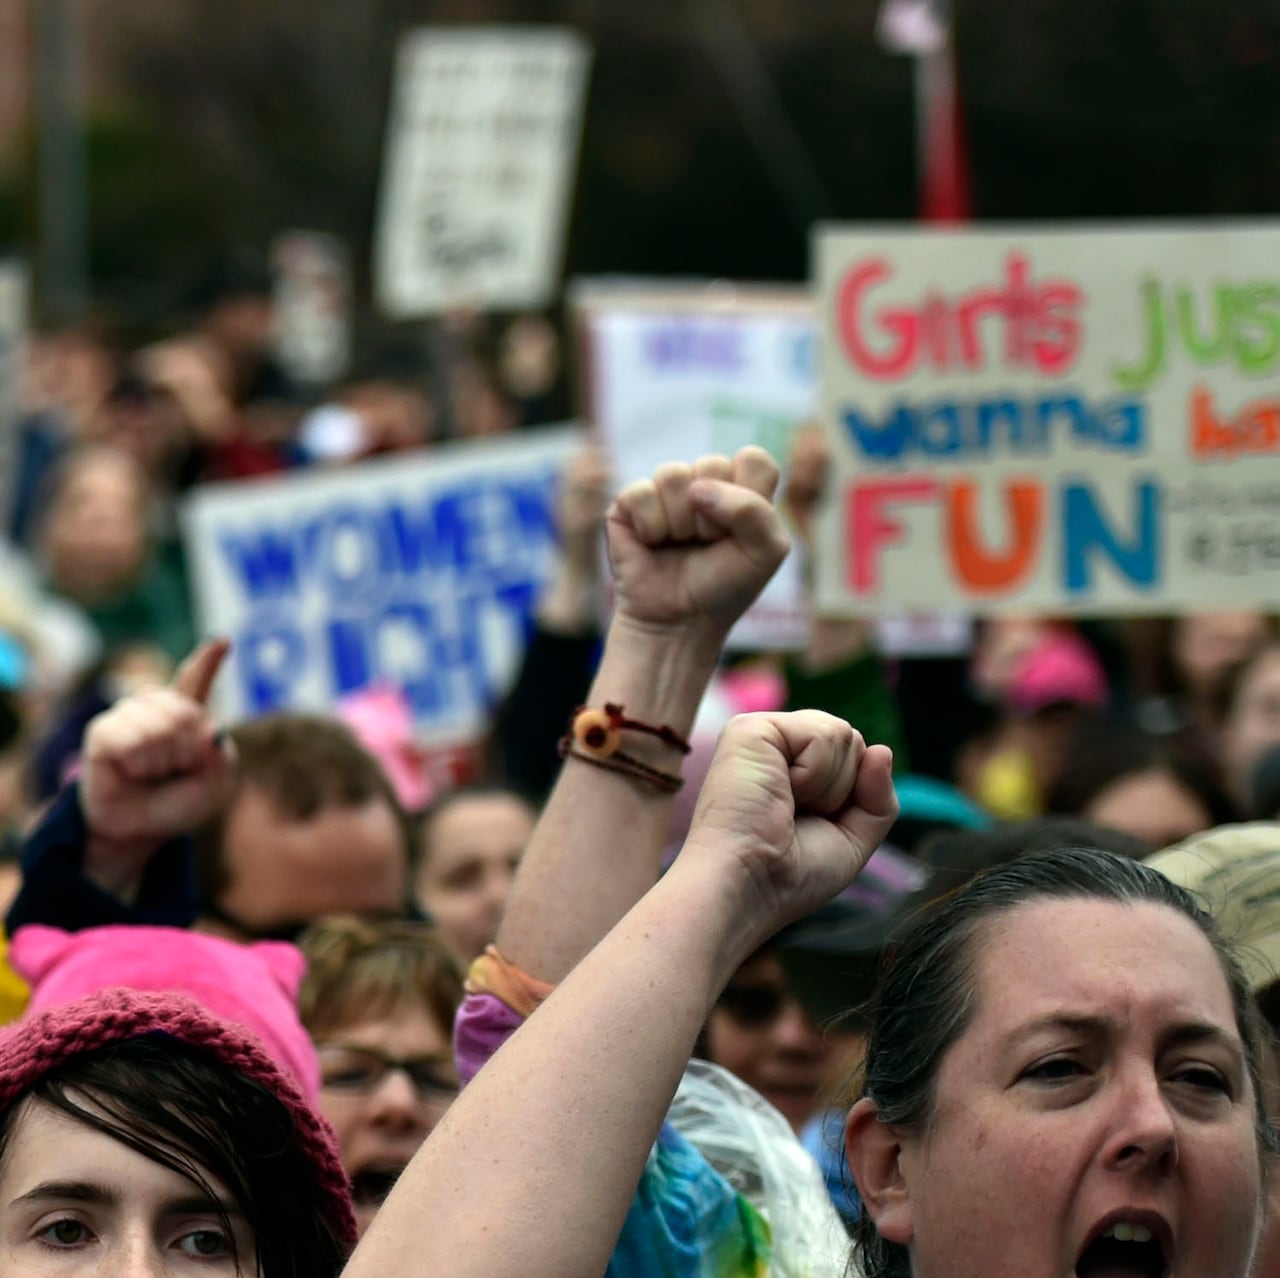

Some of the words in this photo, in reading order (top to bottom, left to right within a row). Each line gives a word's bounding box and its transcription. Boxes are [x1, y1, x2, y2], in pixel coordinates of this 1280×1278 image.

[838, 250, 1083, 382] Girls
[845, 393, 1148, 461] wanna
[845, 477, 1162, 593] FUN
